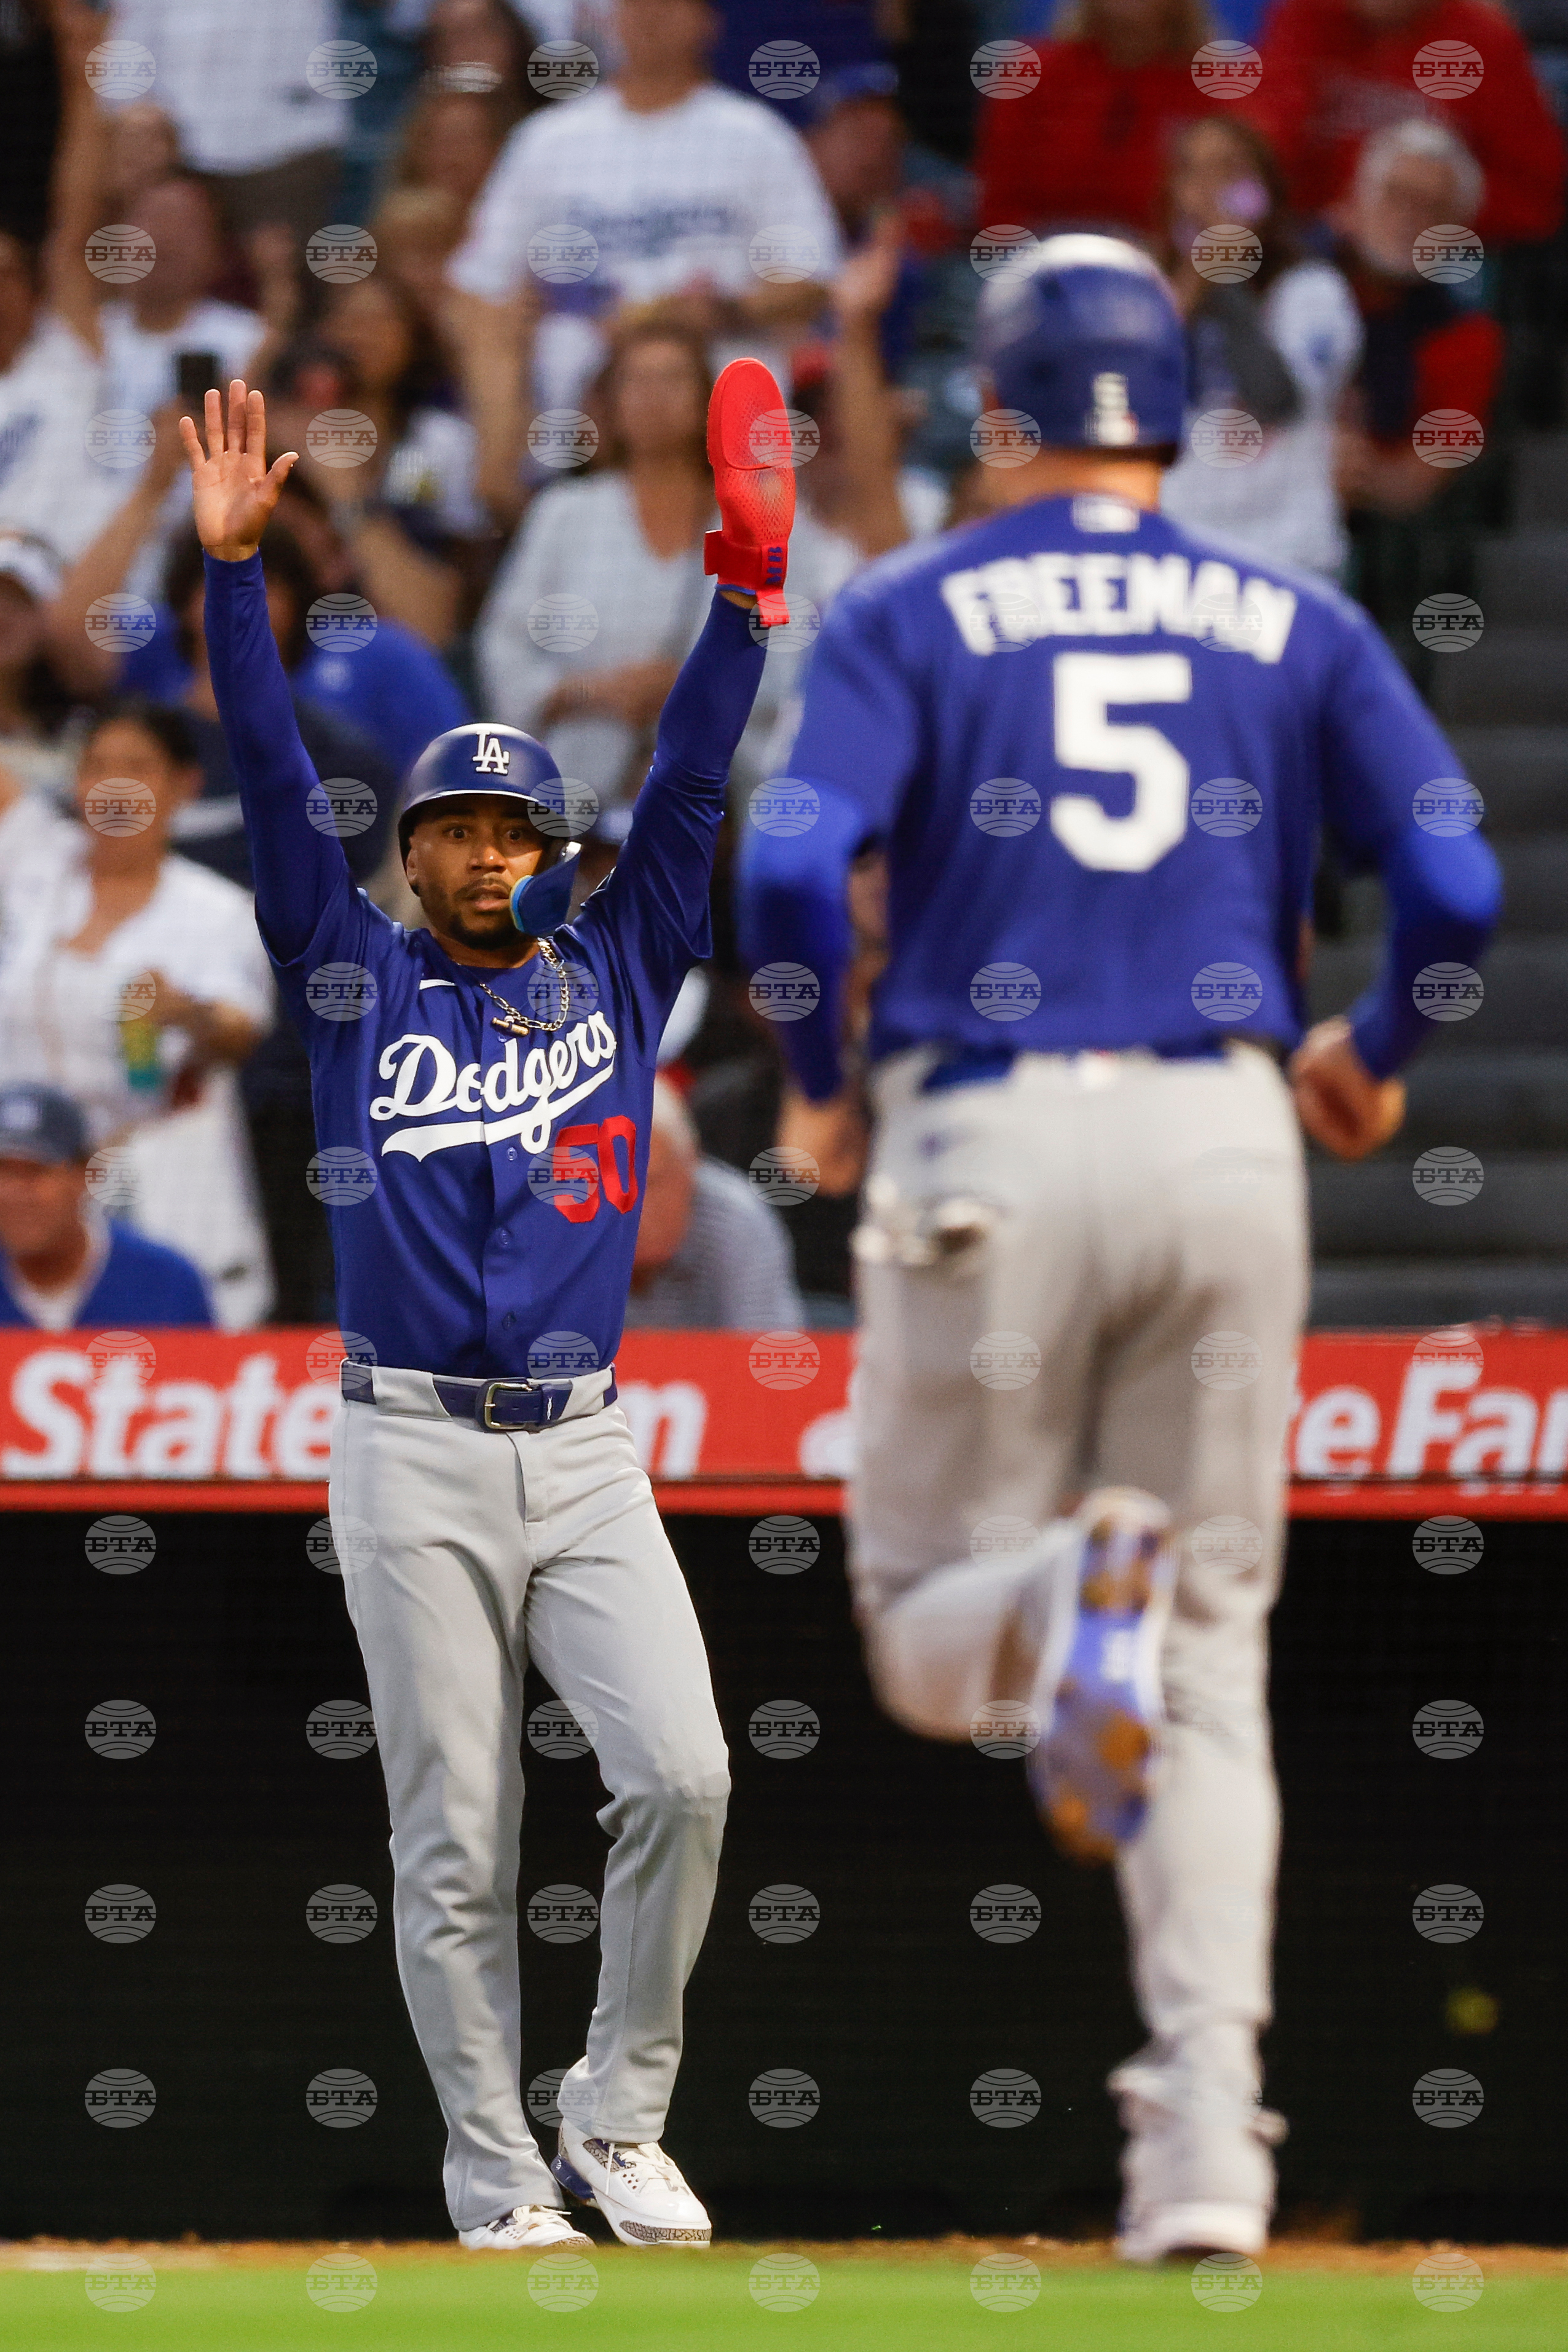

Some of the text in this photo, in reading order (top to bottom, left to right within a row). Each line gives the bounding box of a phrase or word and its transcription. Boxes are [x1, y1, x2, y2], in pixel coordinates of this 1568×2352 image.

[941, 551, 1296, 665] FREEMAN
[472, 731, 510, 775] LA
[1050, 652, 1191, 872] 5
[369, 1011, 617, 1154] Dodgers
[553, 1115, 638, 1223] 50
[2, 1347, 337, 1479] State
